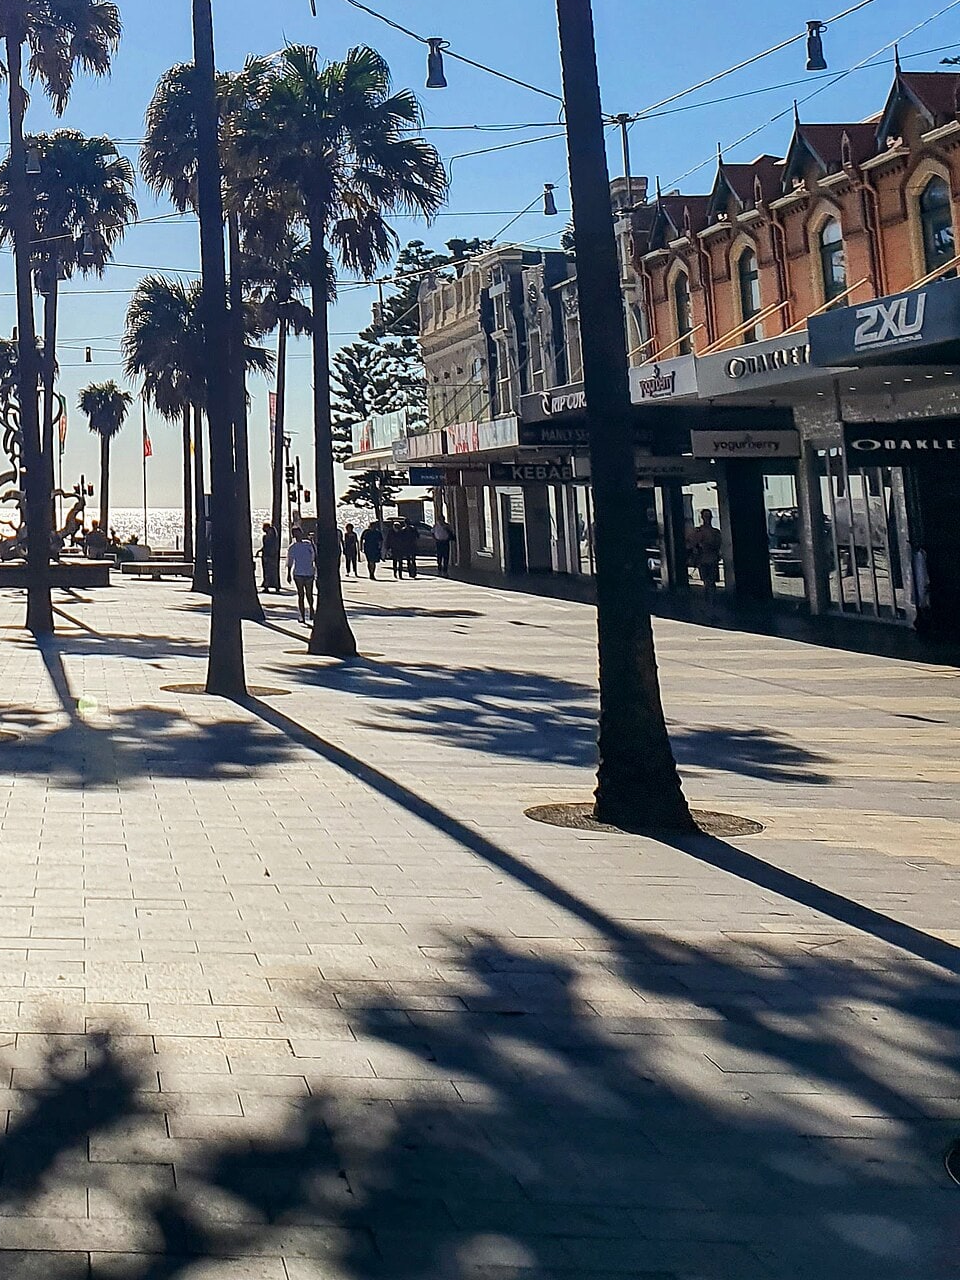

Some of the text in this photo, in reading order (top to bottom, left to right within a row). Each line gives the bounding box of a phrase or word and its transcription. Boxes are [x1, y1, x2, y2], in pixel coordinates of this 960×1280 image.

[855, 292, 927, 345] 2XU
[551, 391, 588, 413] RIP CUR
[884, 439, 960, 450] OAKLE
